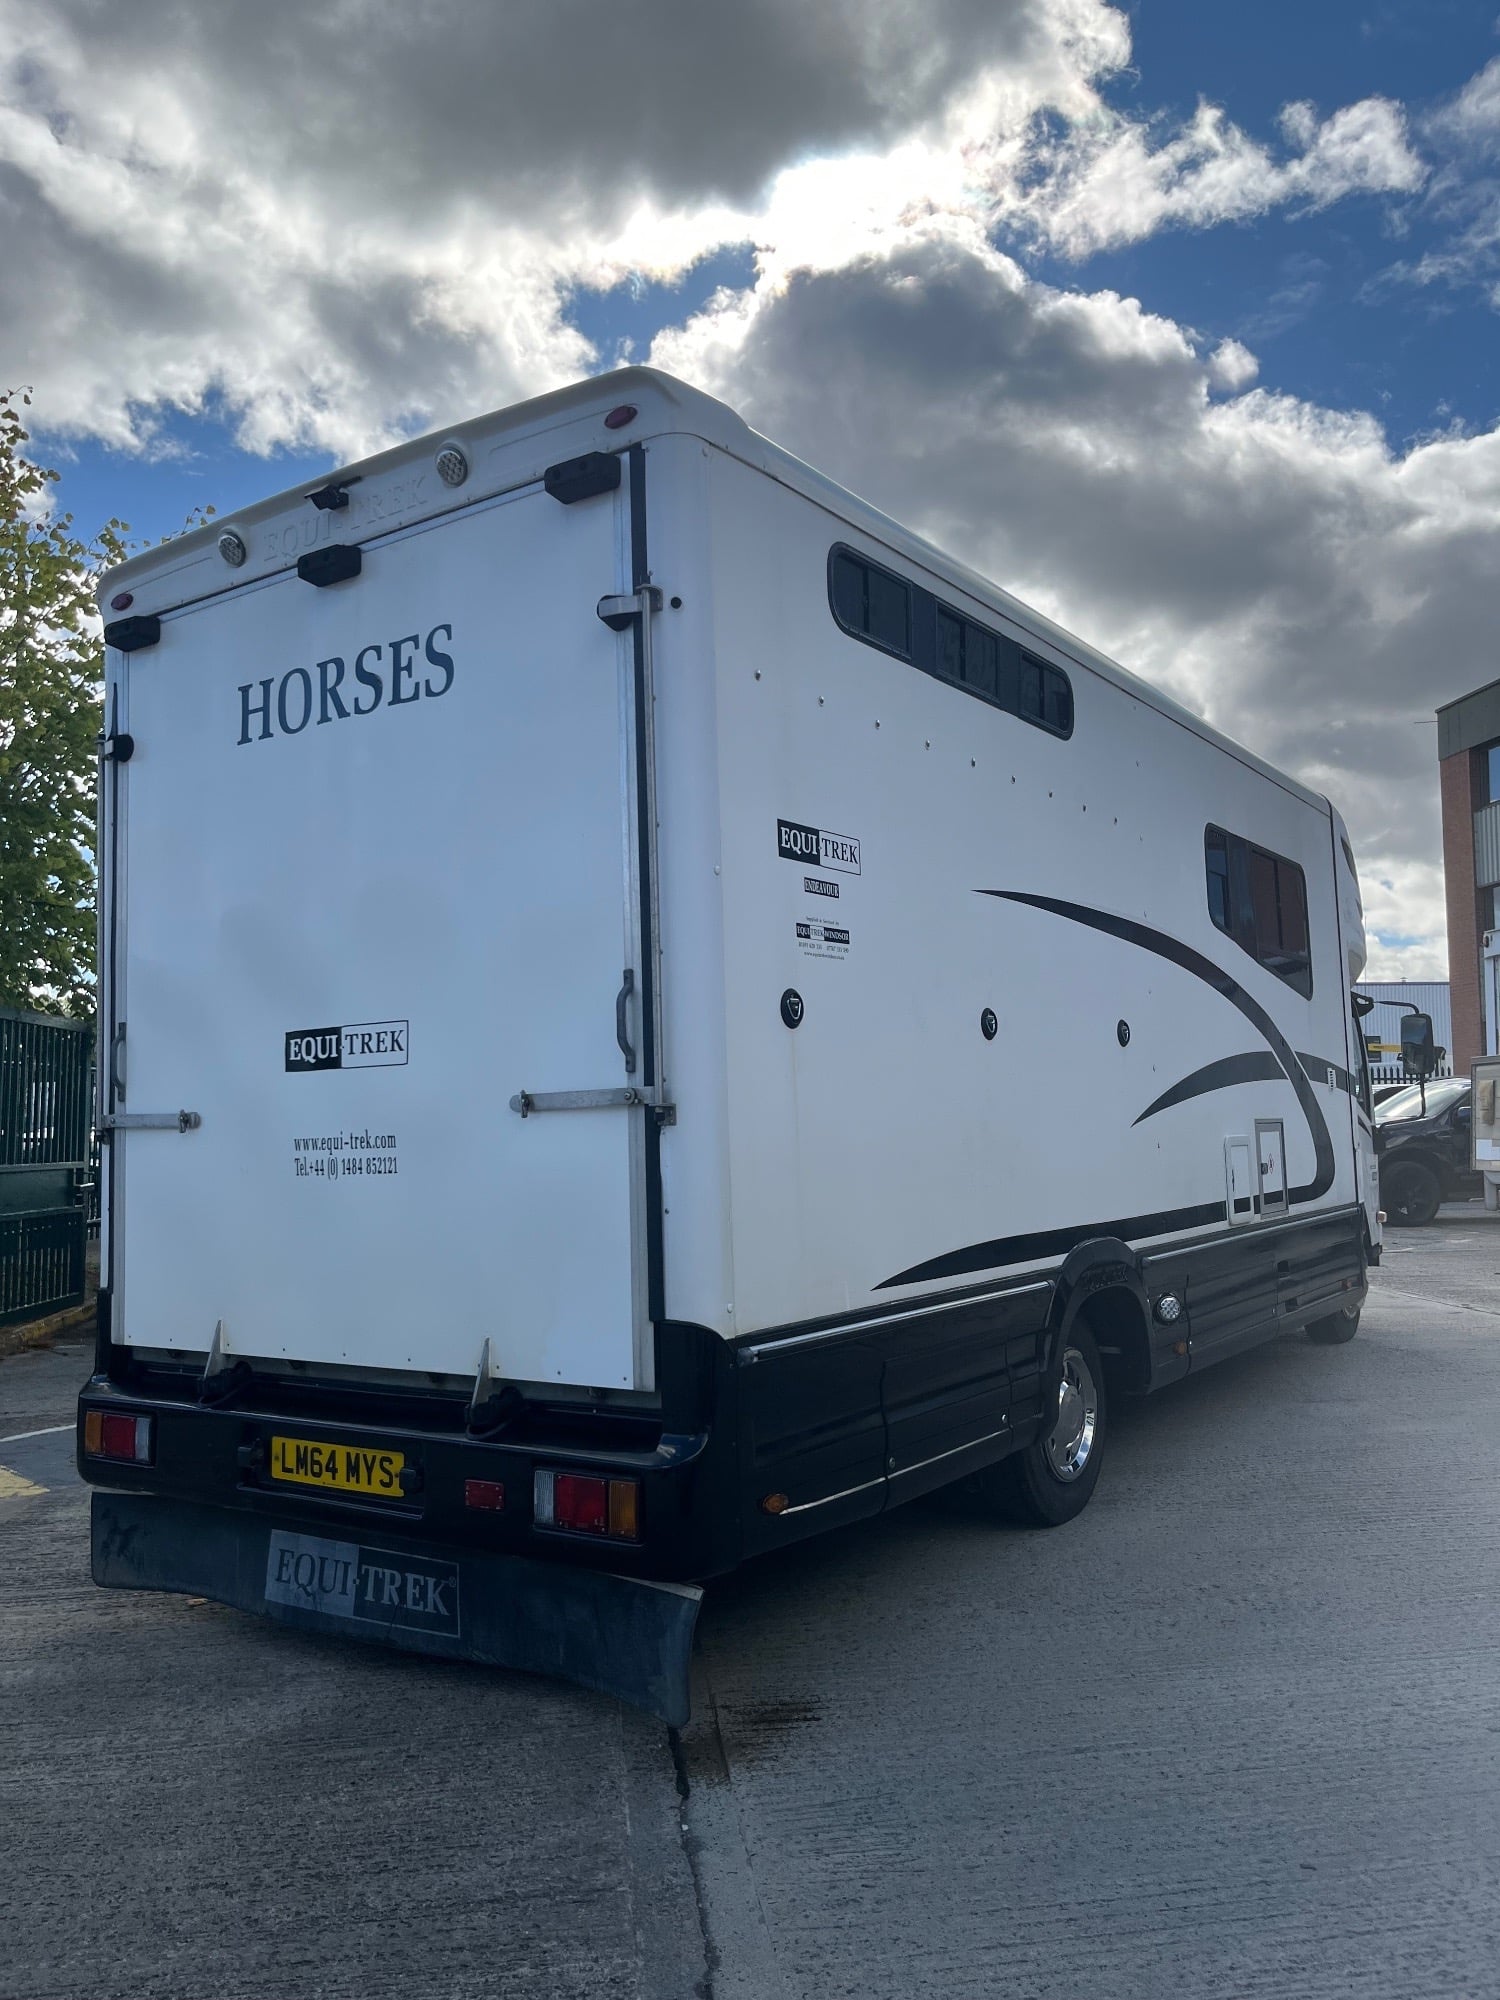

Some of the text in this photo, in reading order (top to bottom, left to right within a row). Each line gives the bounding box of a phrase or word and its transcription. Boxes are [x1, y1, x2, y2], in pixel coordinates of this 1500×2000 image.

[237, 623, 455, 746] HORSES
[804, 878, 839, 897] ENDEAVOUR
[294, 1129, 396, 1155] www.equi-trek.com
[327, 1157, 338, 1180] (0)
[341, 1157, 363, 1176] 1484
[366, 1157, 398, 1175] 852121
[281, 1442, 394, 1489] LM64 MYS
